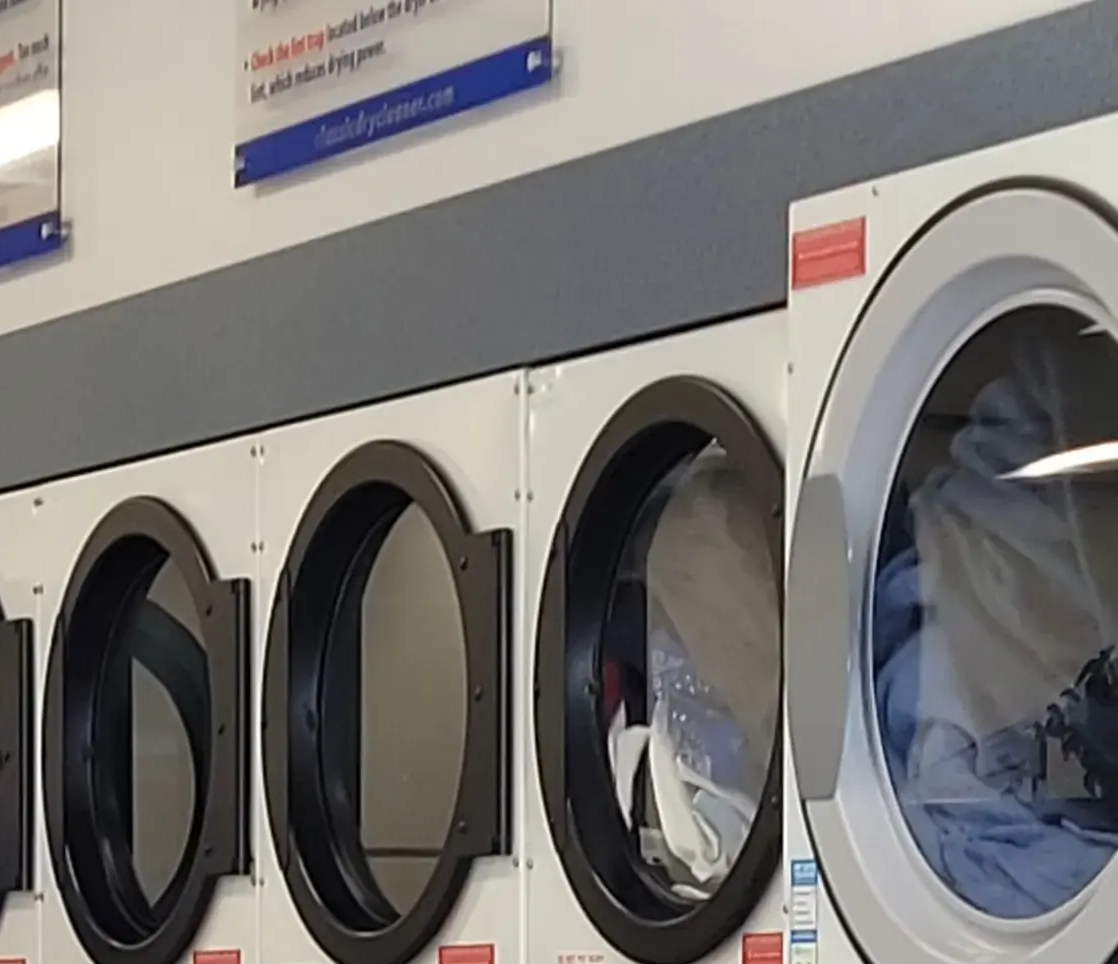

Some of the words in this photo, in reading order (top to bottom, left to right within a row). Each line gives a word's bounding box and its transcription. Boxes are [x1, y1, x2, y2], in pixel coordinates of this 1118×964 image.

[251, 44, 273, 71] Check
[276, 39, 289, 62] the
[327, 14, 357, 42] located
[360, 6, 385, 31] below
[387, 0, 401, 20] the
[269, 70, 292, 95] which
[295, 63, 326, 87] reduces
[328, 48, 355, 76] drying
